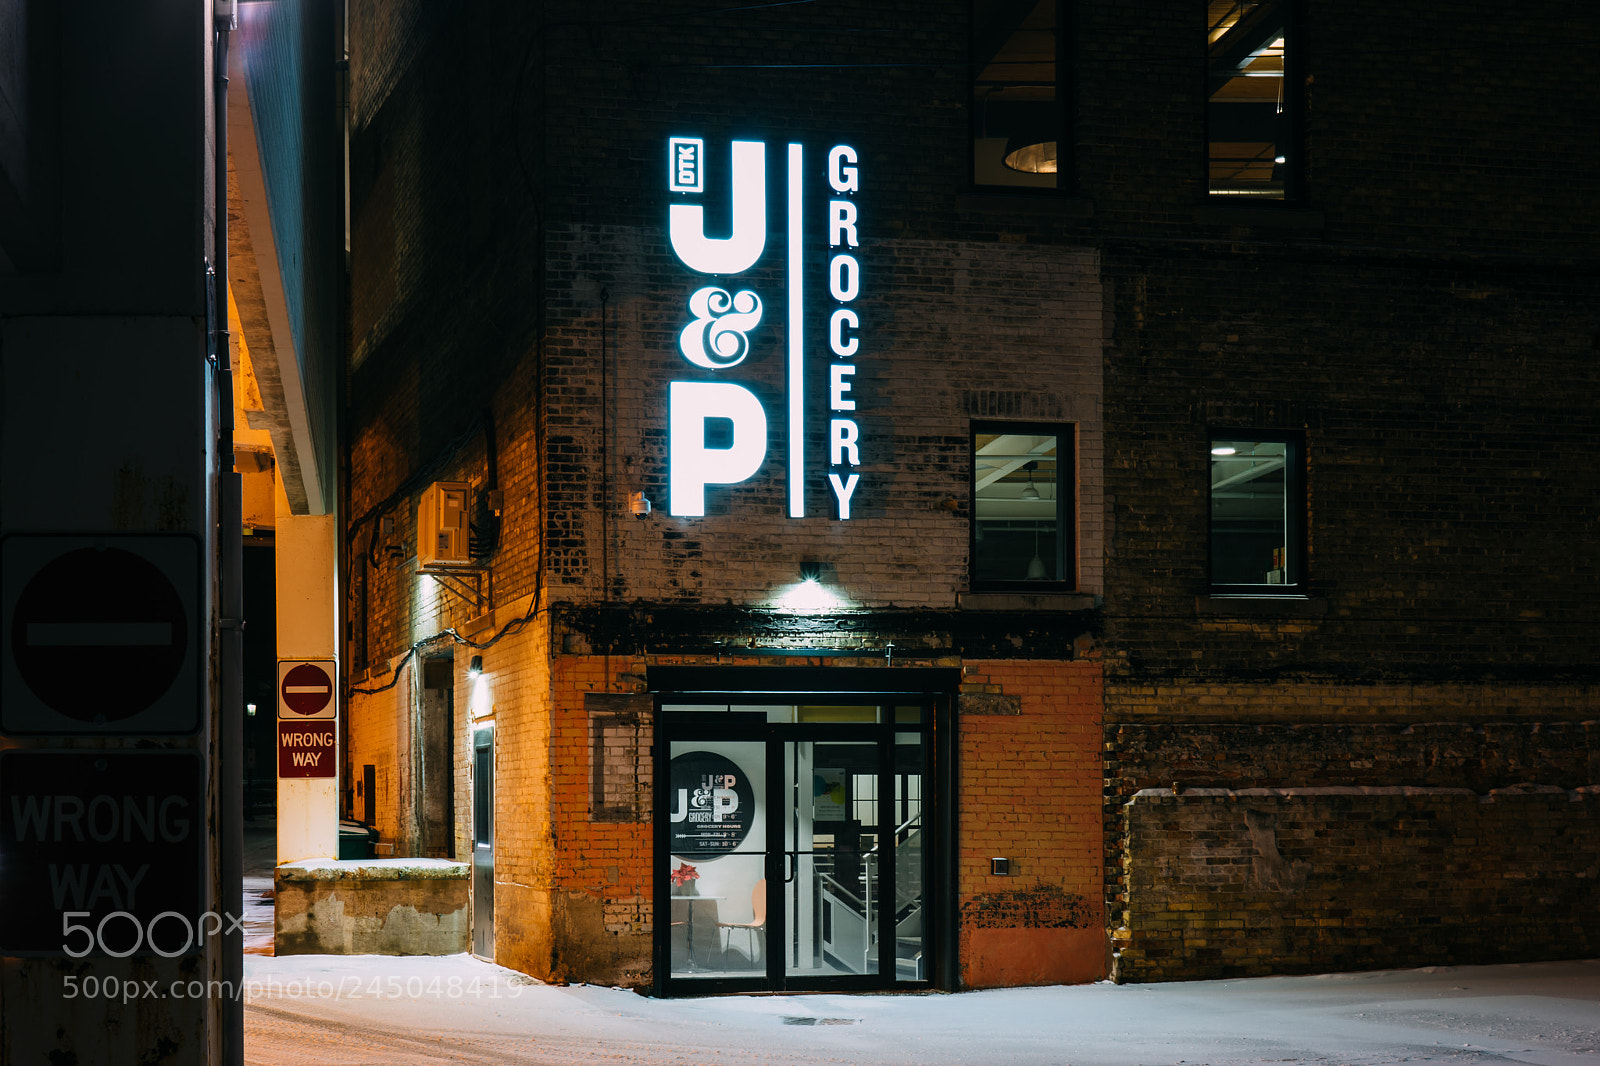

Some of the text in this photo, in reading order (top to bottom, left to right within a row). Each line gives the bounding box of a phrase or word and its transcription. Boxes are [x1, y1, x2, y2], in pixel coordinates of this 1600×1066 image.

[678, 146, 695, 185] DTK
[828, 145, 860, 520] GROCERY
[281, 732, 334, 748] WRONG
[292, 752, 322, 767] WAY
[11, 795, 190, 844] WRONG
[48, 863, 151, 912] WAY
